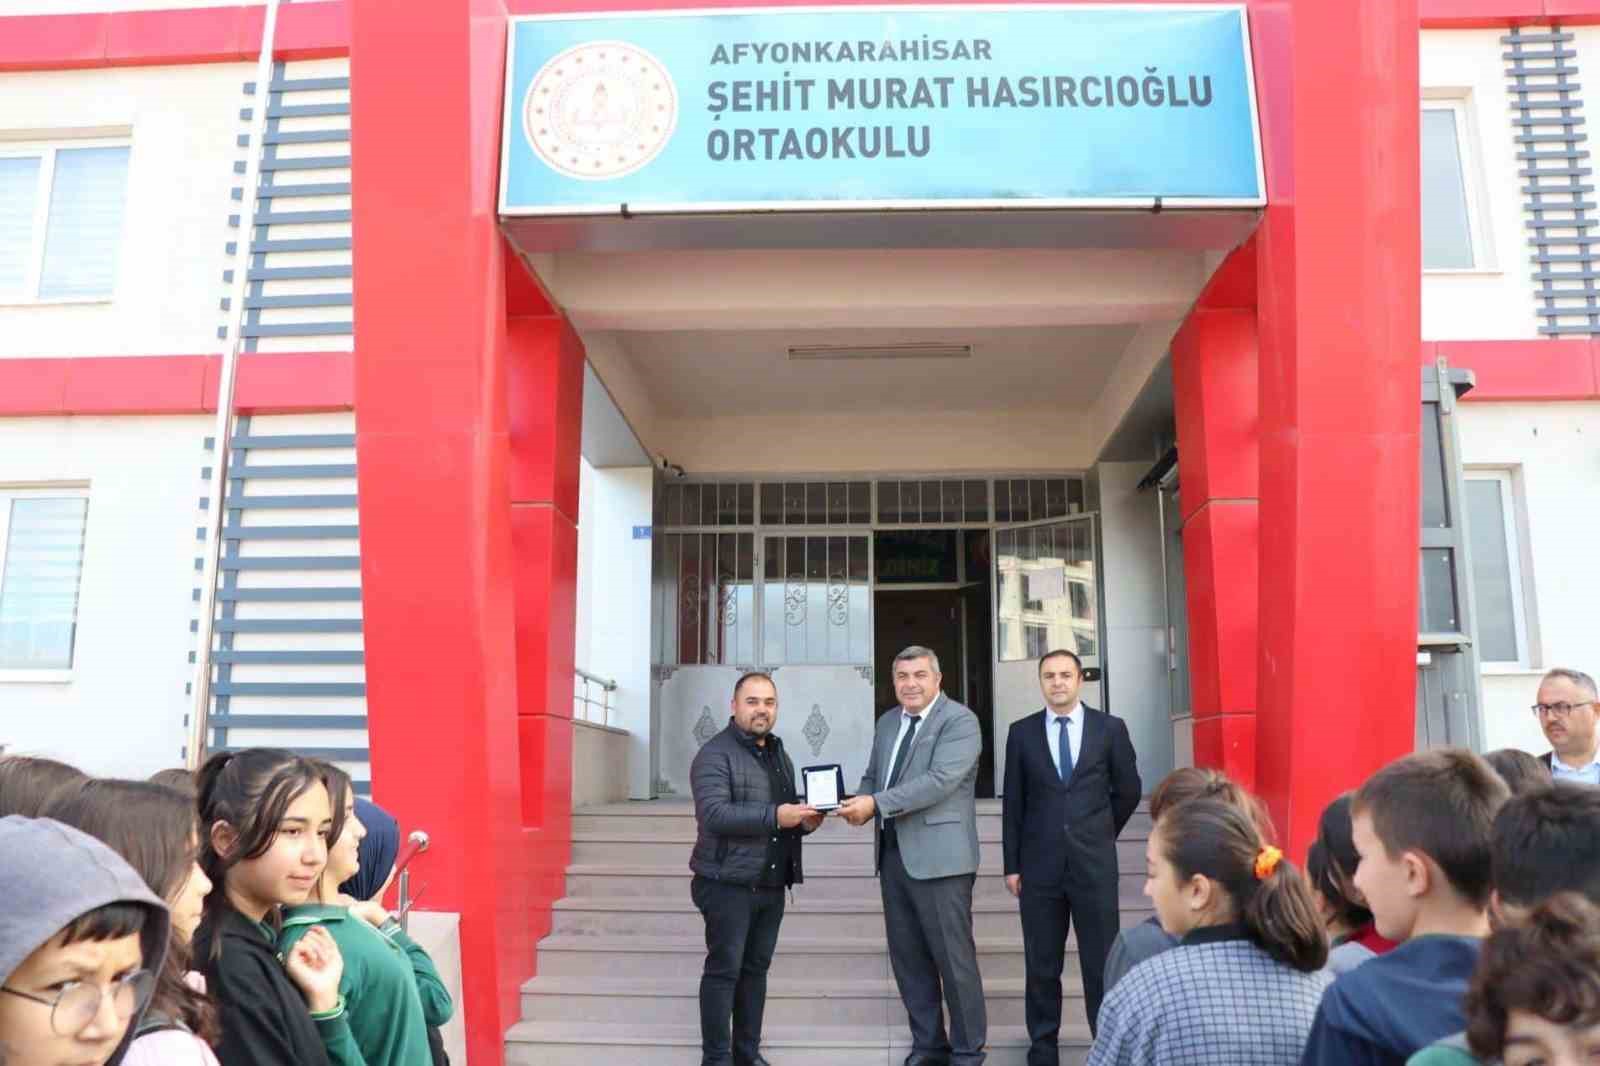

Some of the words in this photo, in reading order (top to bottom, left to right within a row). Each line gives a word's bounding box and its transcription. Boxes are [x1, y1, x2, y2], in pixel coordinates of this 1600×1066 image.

[710, 34, 992, 65] AFYONKARAHİSAR
[707, 72, 815, 121] ŞEHİT
[827, 77, 955, 110] MURAT
[966, 66, 1213, 108] HASIRCIOĞLU
[707, 126, 931, 161] ORTAOKULU
